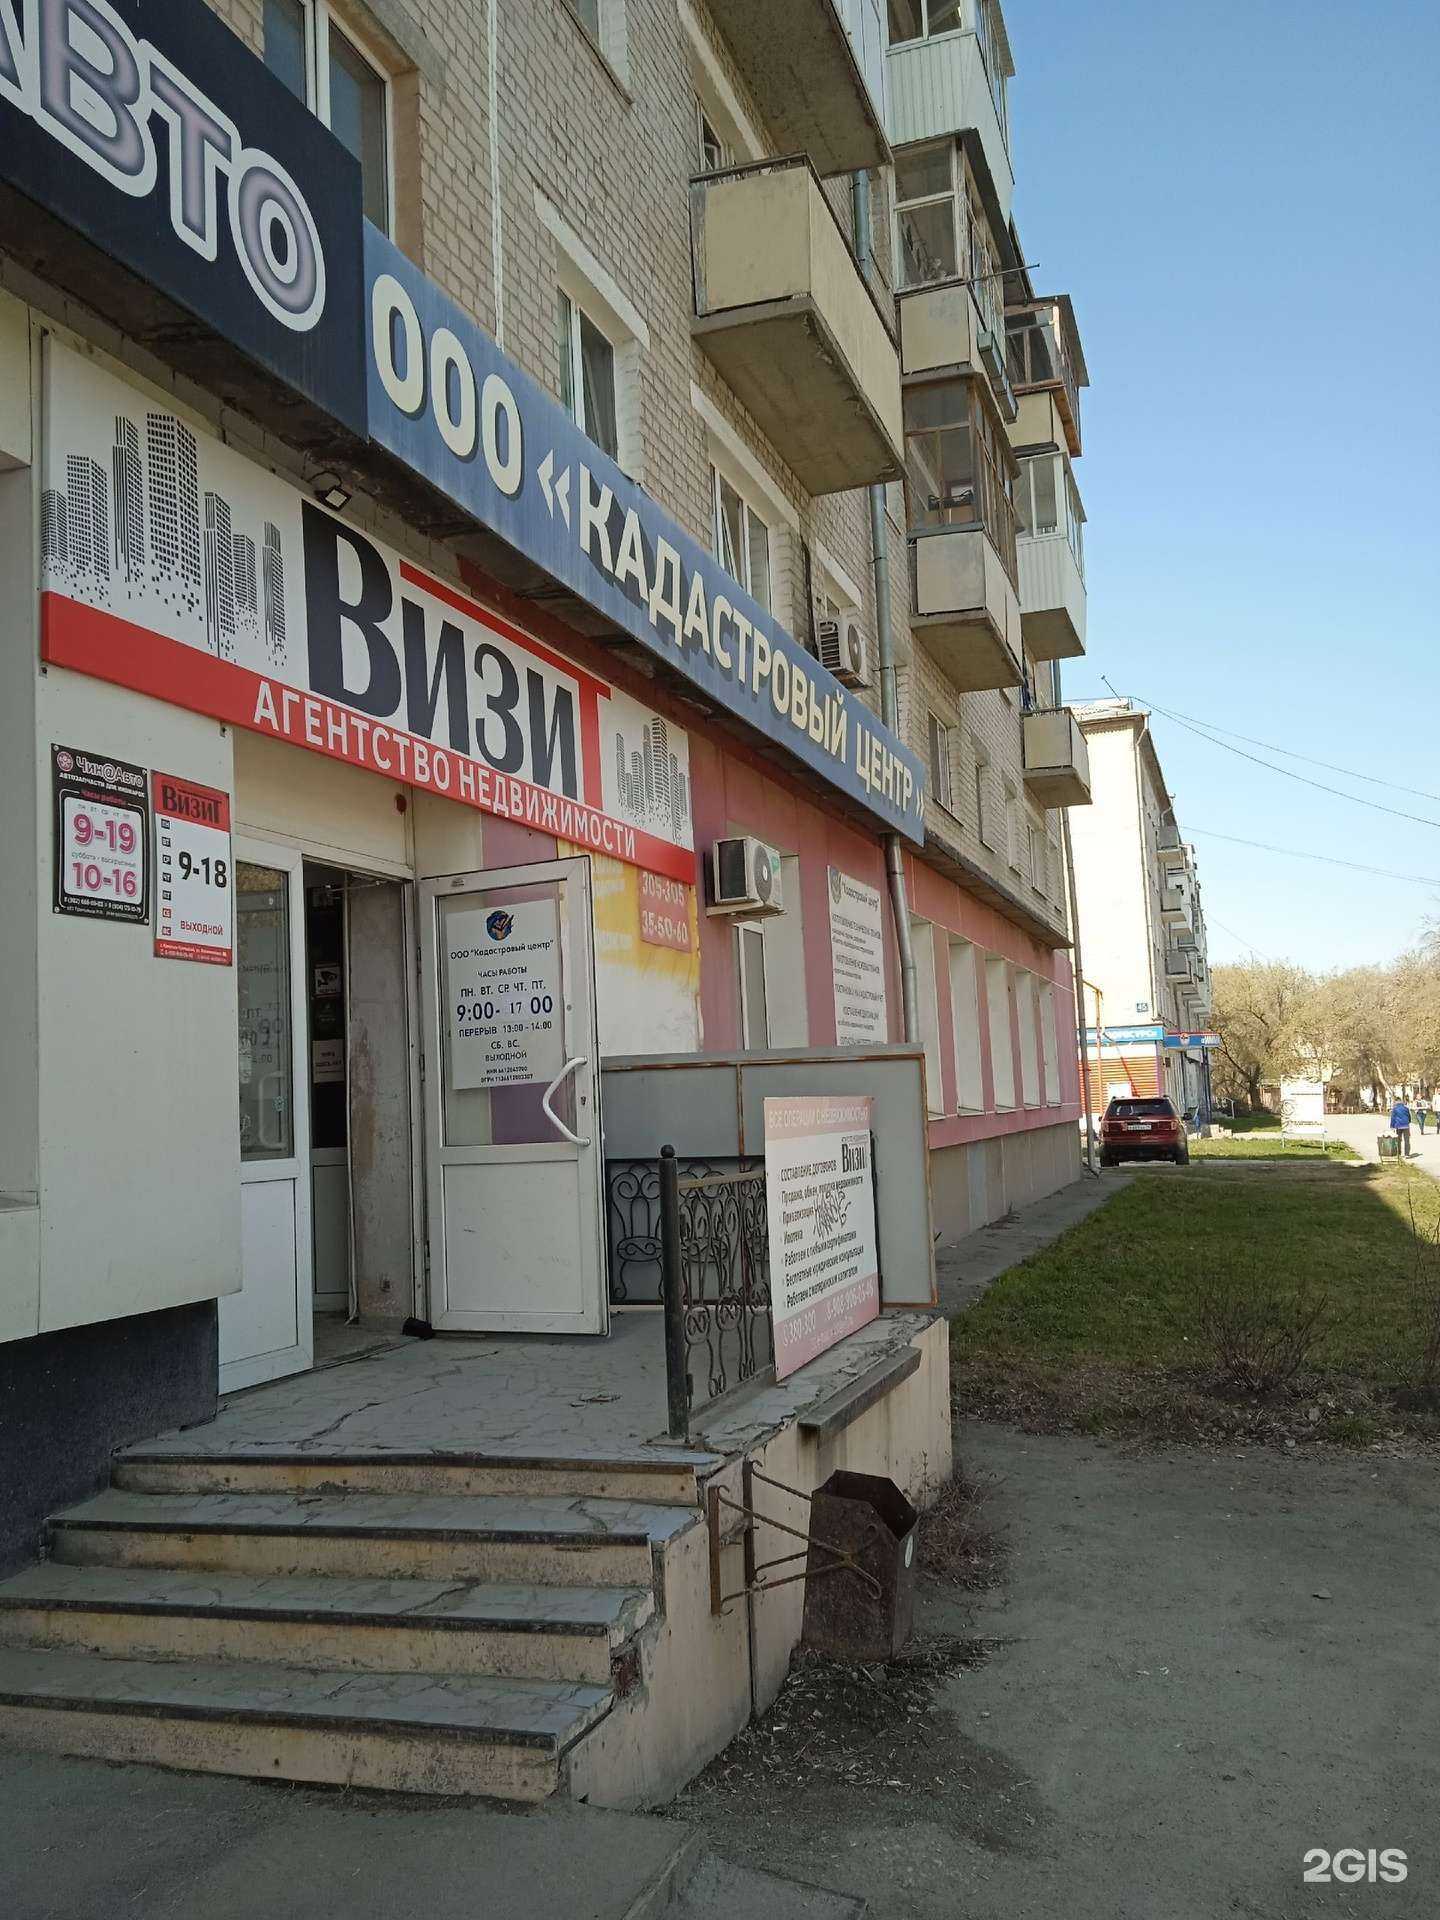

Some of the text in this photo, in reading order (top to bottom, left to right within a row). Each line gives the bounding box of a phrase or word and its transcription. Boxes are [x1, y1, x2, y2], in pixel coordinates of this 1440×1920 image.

[371, 273, 524, 496] ООО
[253, 680, 636, 860] АГЕНТСТВО НЕДВИЖИМОСТИ
[73, 814, 136, 854] 9-19
[178, 851, 227, 888] 9-18
[72, 862, 137, 897] 10-16
[180, 920, 223, 935] ВЫХОДНОЙ
[450, 950, 469, 960] ООО
[477, 966, 528, 979] ЧАСЫ РАБОТЫ
[509, 1002, 522, 1014] 17
[530, 996, 553, 1015] 00
[458, 1026, 497, 1038] ПЕРЕРЫВ
[485, 1050, 527, 1062] ВЫХОДНОЙ
